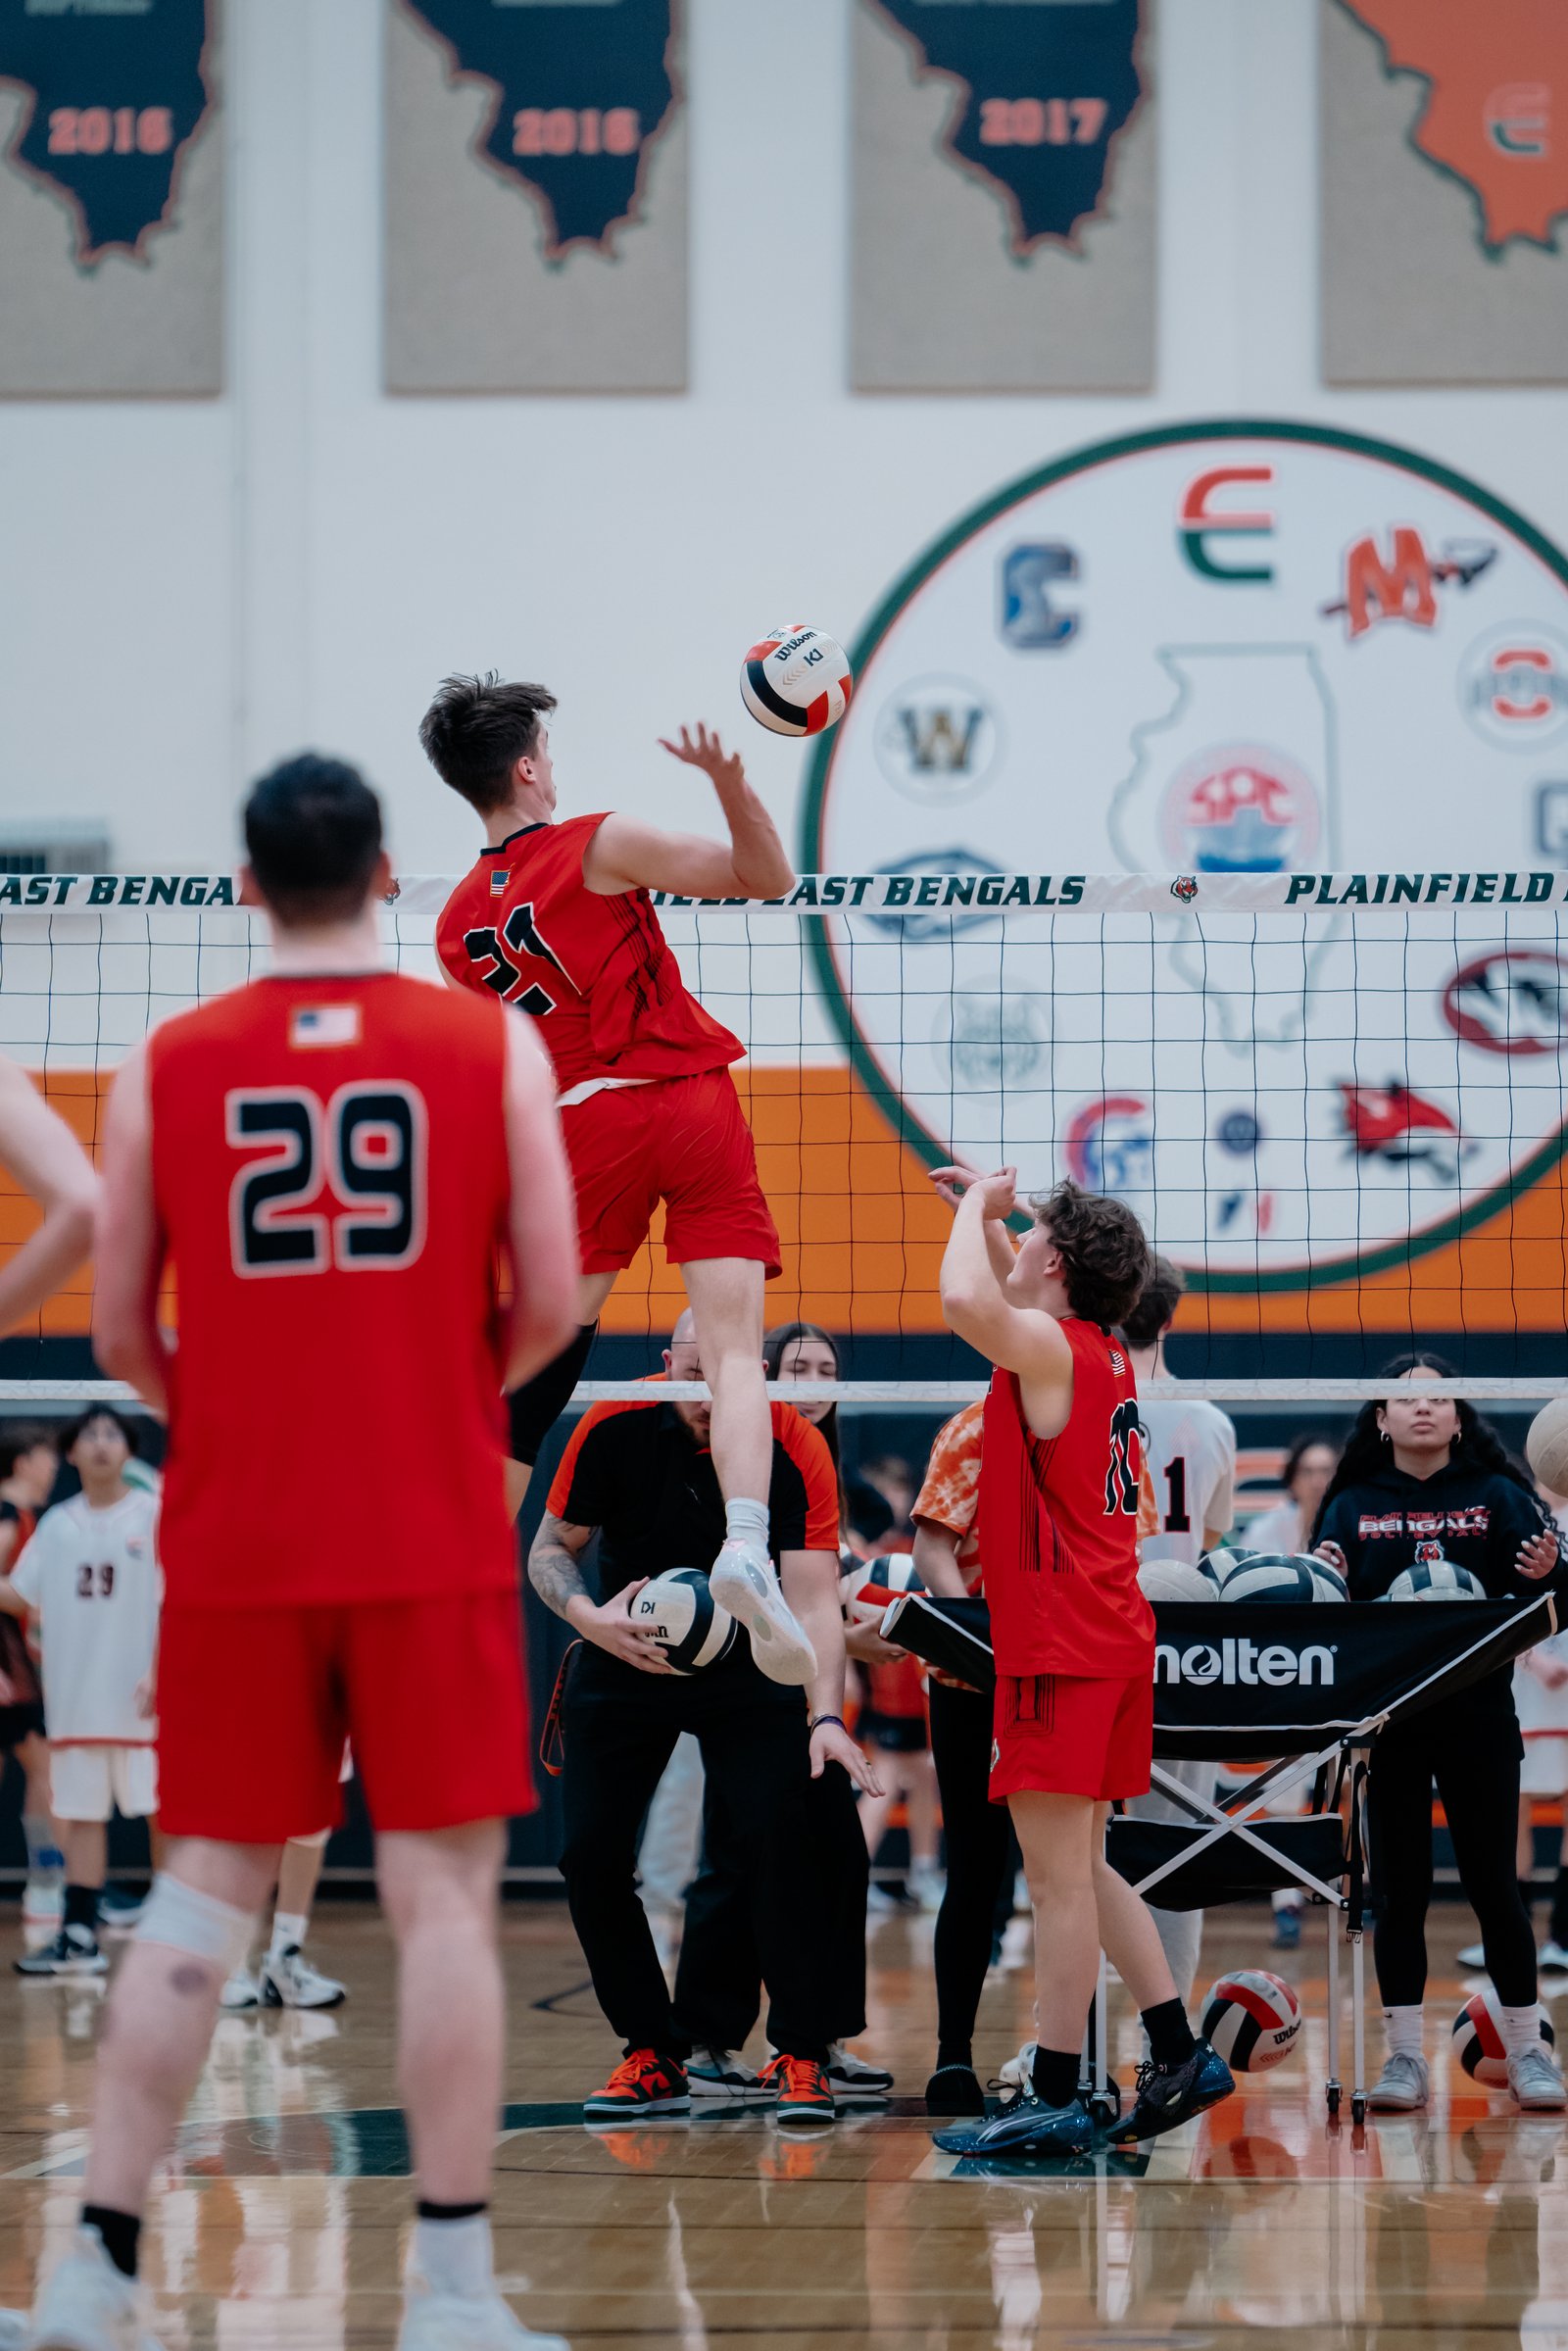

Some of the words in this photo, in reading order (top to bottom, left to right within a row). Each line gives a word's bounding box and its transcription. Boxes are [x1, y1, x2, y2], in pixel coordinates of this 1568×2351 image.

[981, 100, 1107, 145] 2017
[774, 630, 817, 661] Wilson
[0, 876, 78, 906] AST
[85, 876, 238, 906] BENGA
[761, 876, 875, 906] AST
[881, 875, 1087, 906] BENGALS
[1284, 872, 1555, 905] PLAINFIELD
[223, 1079, 429, 1280] 29
